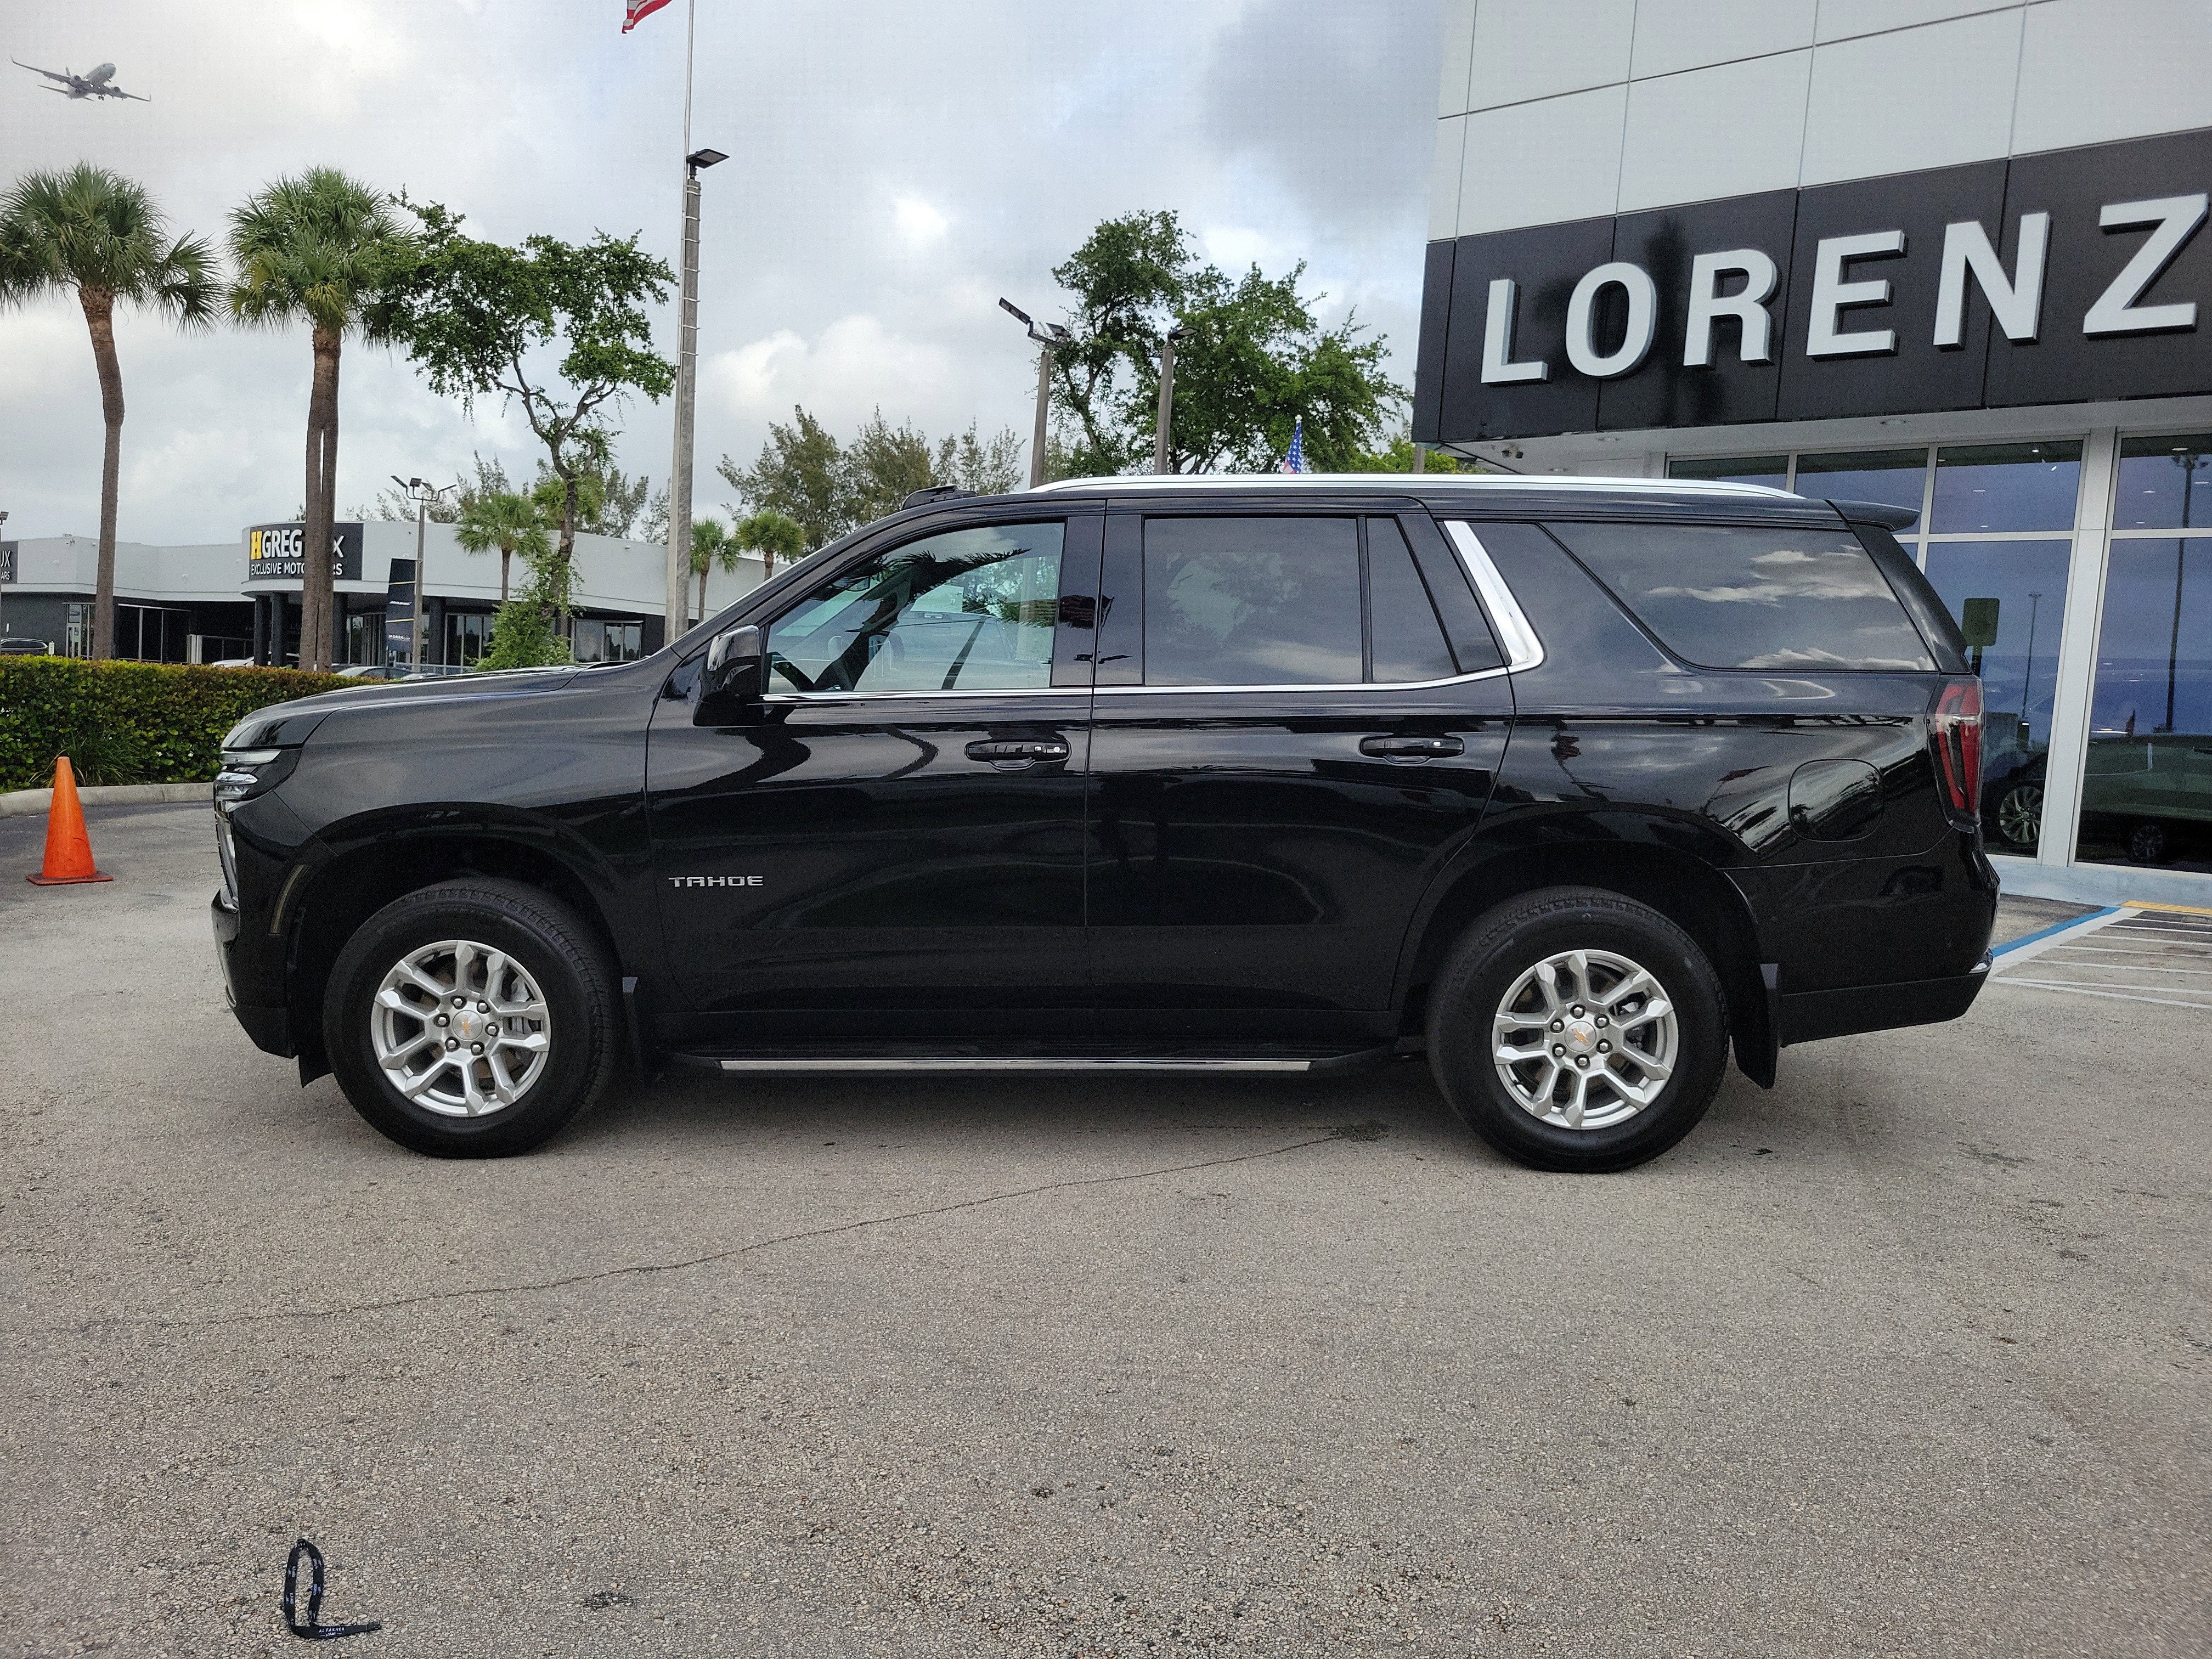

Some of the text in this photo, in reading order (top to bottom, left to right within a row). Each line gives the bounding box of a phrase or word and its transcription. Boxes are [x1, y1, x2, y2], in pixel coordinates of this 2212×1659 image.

[1481, 193, 2209, 383] LORENZ
[251, 562, 281, 575] EXCLUSIVE
[668, 876, 764, 887] TAHOE
